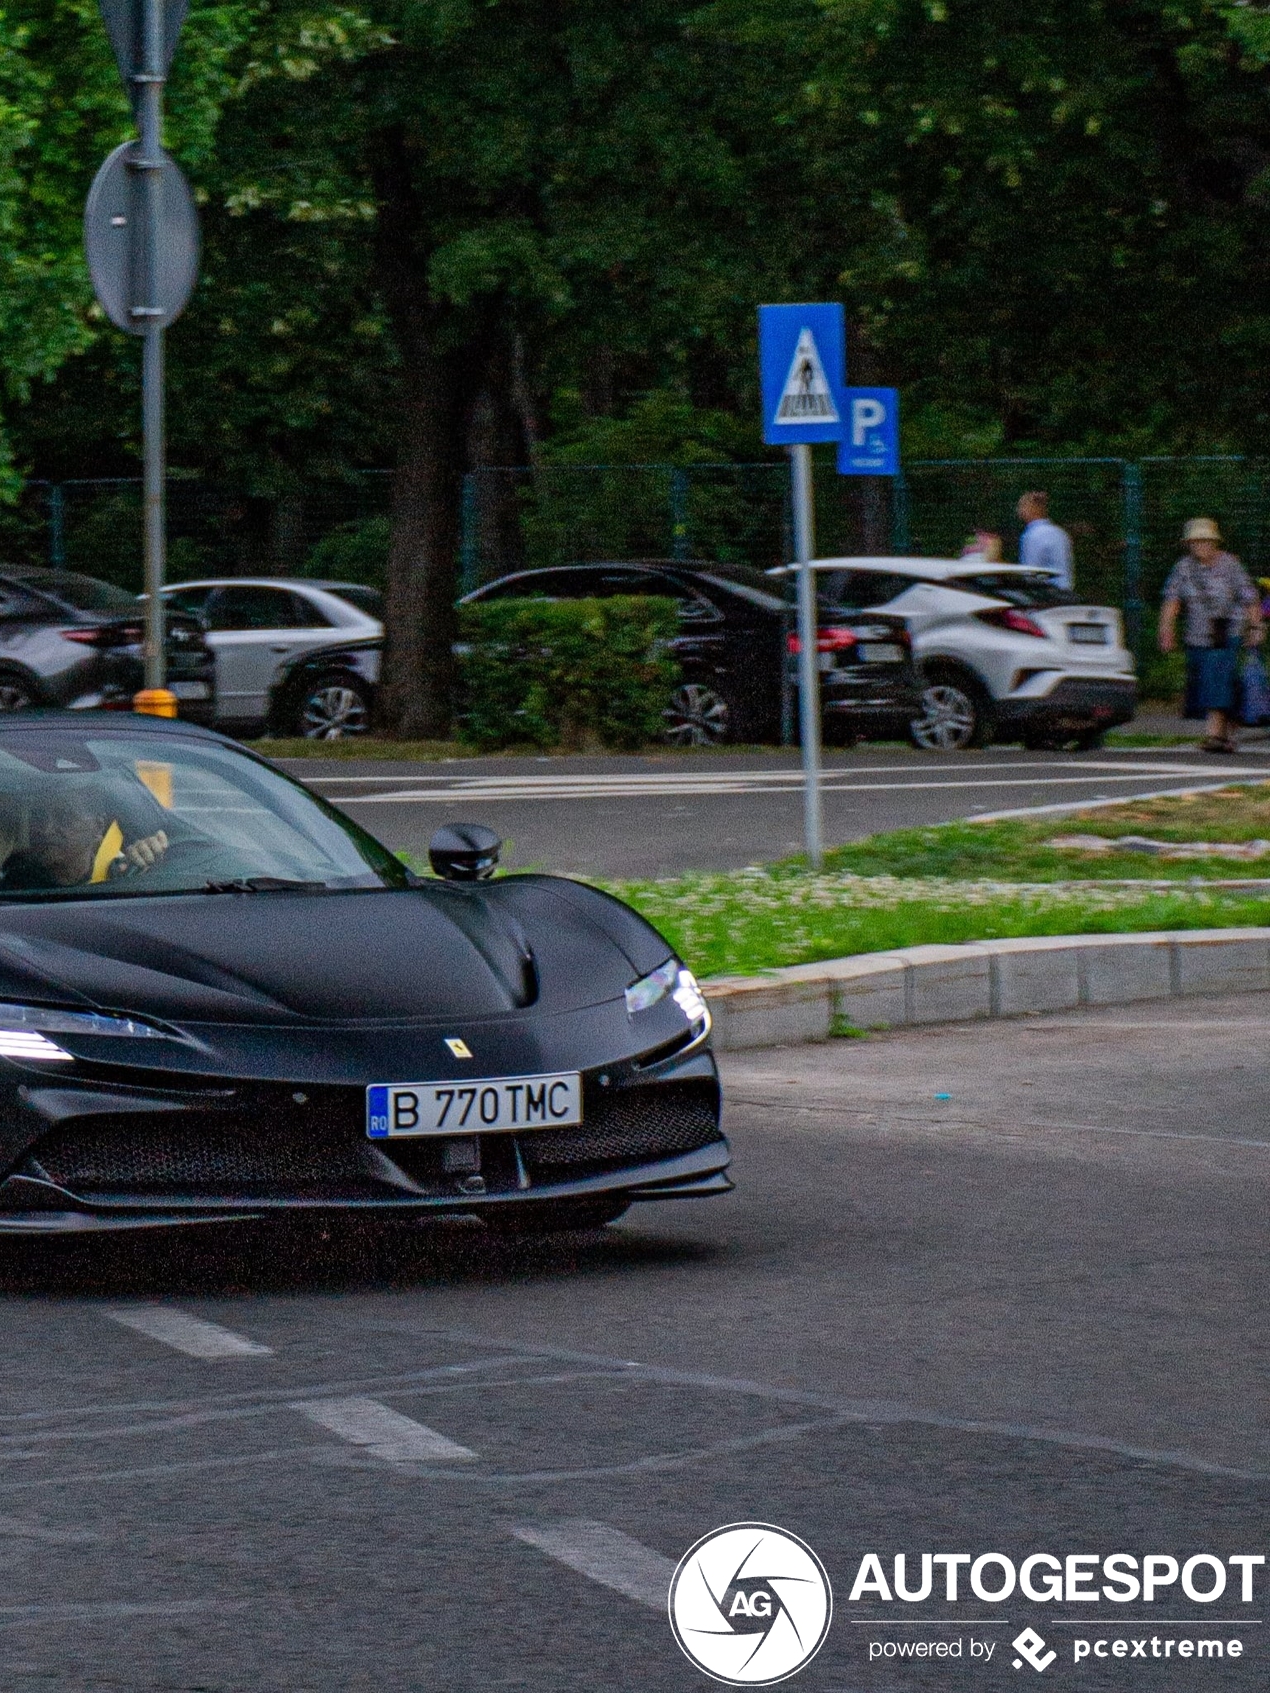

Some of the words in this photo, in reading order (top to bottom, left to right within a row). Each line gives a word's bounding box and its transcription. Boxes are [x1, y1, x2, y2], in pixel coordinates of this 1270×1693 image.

[852, 398, 886, 446] P
[371, 1115, 388, 1131] RO
[394, 1091, 419, 1129] B
